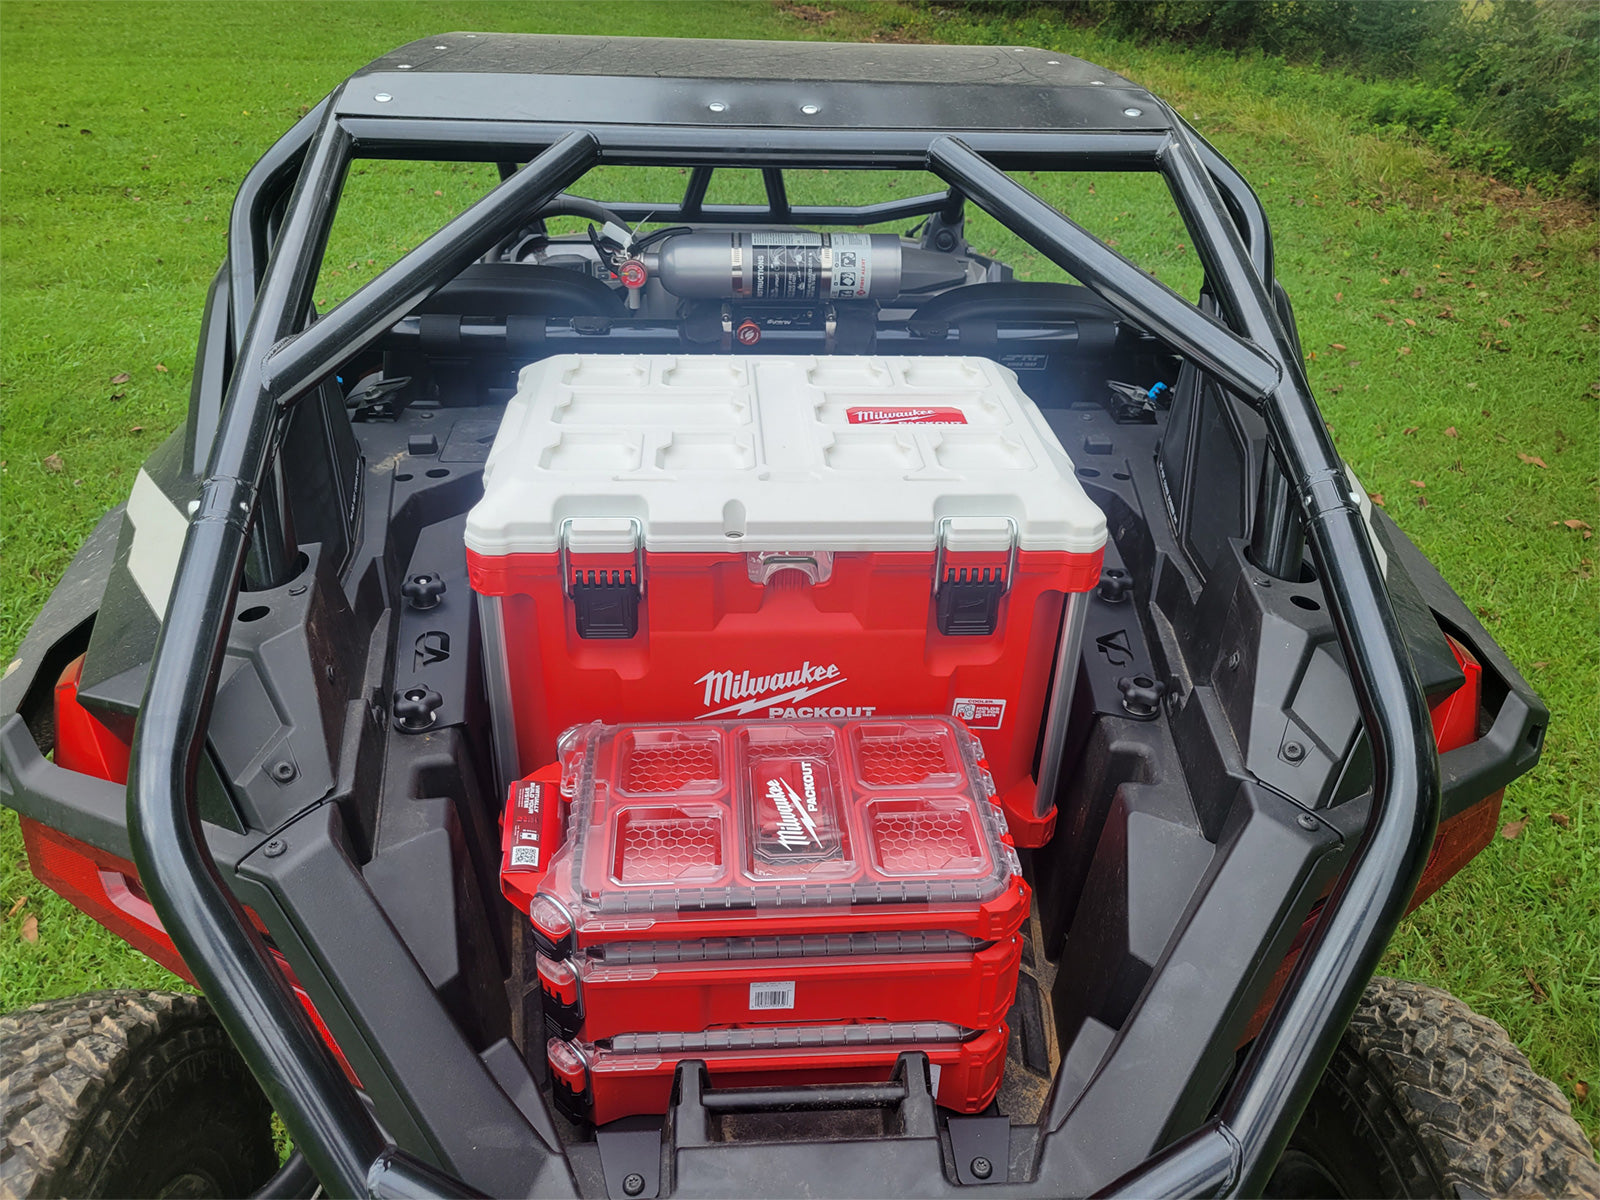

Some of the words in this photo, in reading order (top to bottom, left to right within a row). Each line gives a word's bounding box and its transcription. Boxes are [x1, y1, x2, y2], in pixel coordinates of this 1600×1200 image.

[852, 409, 935, 421] Milwaukee
[694, 661, 840, 707] Milwaukee
[769, 707, 876, 718] PACKOUT
[801, 761, 818, 812] PACKOUT
[765, 779, 811, 851] Milwaukee
